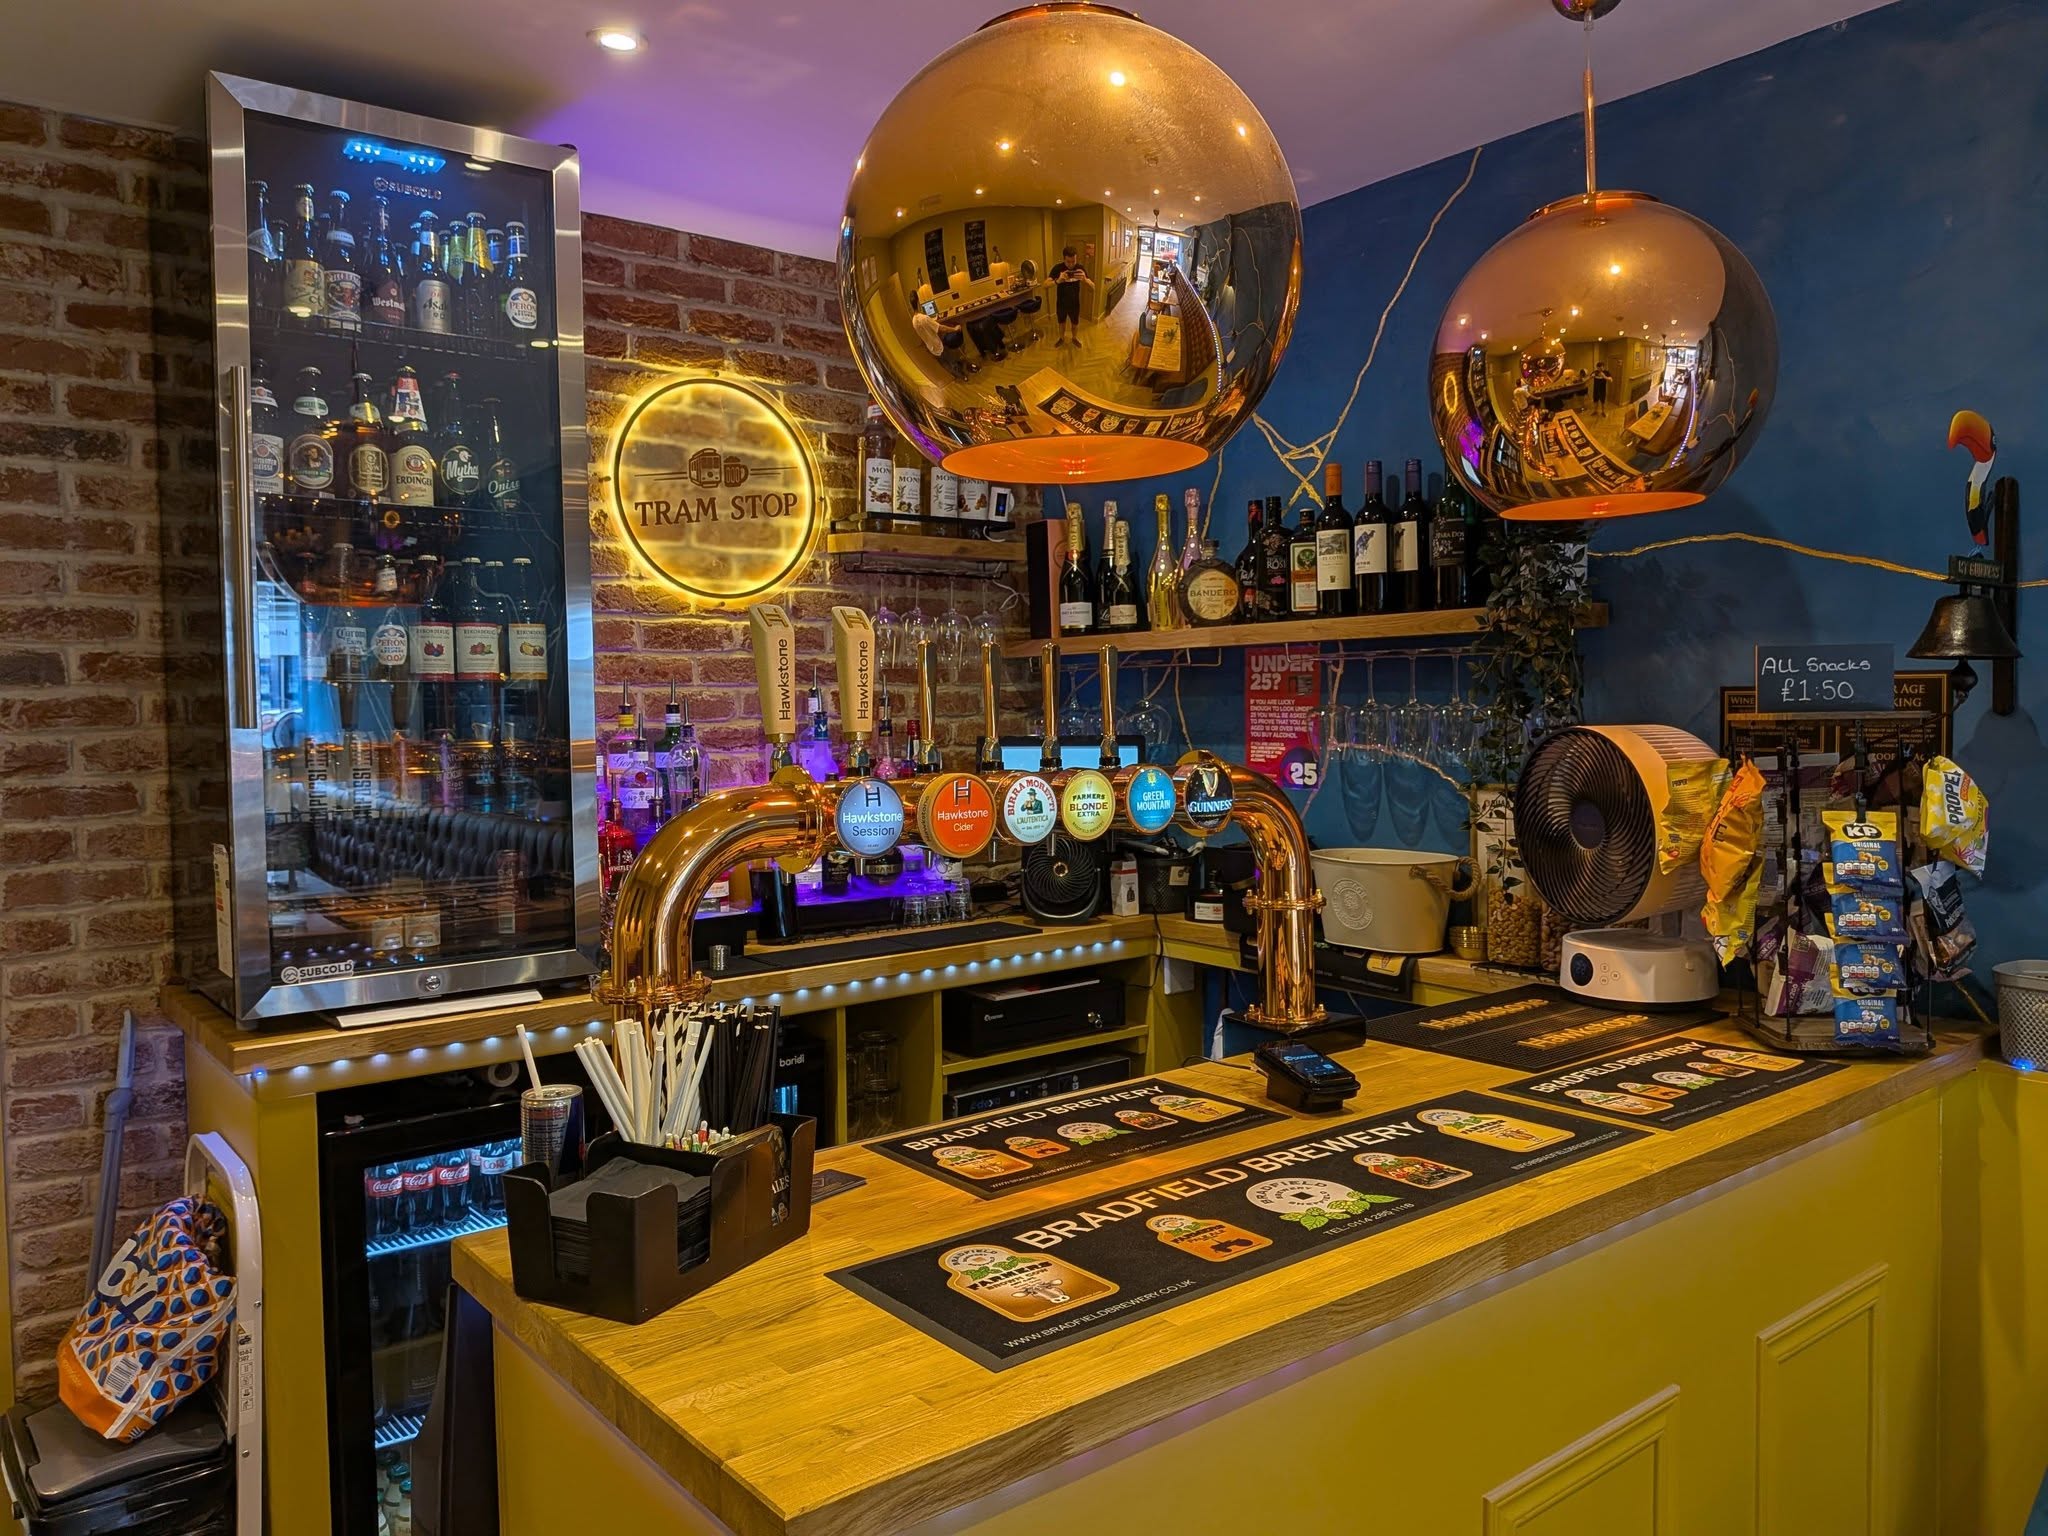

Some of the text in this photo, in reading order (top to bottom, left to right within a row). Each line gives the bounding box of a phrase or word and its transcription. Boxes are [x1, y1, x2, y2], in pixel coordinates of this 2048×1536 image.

[634, 492, 798, 527] TRAM STOP
[1190, 589, 1237, 598] BANDERO
[1251, 655, 1314, 672] UNDER
[1806, 656, 1871, 673] Snacks
[777, 638, 791, 721] Hawkstone
[857, 640, 869, 720] Hawkstone
[1250, 673, 1282, 690] 25?
[1290, 762, 1318, 785] 25
[1008, 778, 1056, 816] BIRRA MORETTI
[1072, 793, 1106, 802] FARMERS
[1142, 790, 1165, 800] GREEN
[1069, 802, 1109, 812] BLONDE
[1136, 800, 1171, 811] MOUNTAIN
[1189, 799, 1233, 813] GUINNESS
[842, 811, 903, 824] Hawkstone
[937, 809, 989, 821] Hawkstone
[852, 825, 895, 837] Session
[953, 823, 974, 832] Cider
[1846, 825, 1879, 837] KP
[300, 963, 353, 979] SUBCOLD
[1419, 998, 1549, 1031] Hawkstone
[1517, 1014, 1649, 1050] Hawkstone
[1529, 1041, 1707, 1094] BRADFIELD BREWERY
[903, 1086, 1165, 1152] BRADFIELD BREWERY
[482, 1158, 507, 1169] Coke
[1012, 1121, 1425, 1249] BRADFIELD BREWERY
[1256, 1180, 1328, 1205] BRADFIELD
[967, 1261, 1053, 1291] FARMERS
[1003, 1278, 1196, 1348] WWW.BRADFIELDBREWERY.CO.UK
